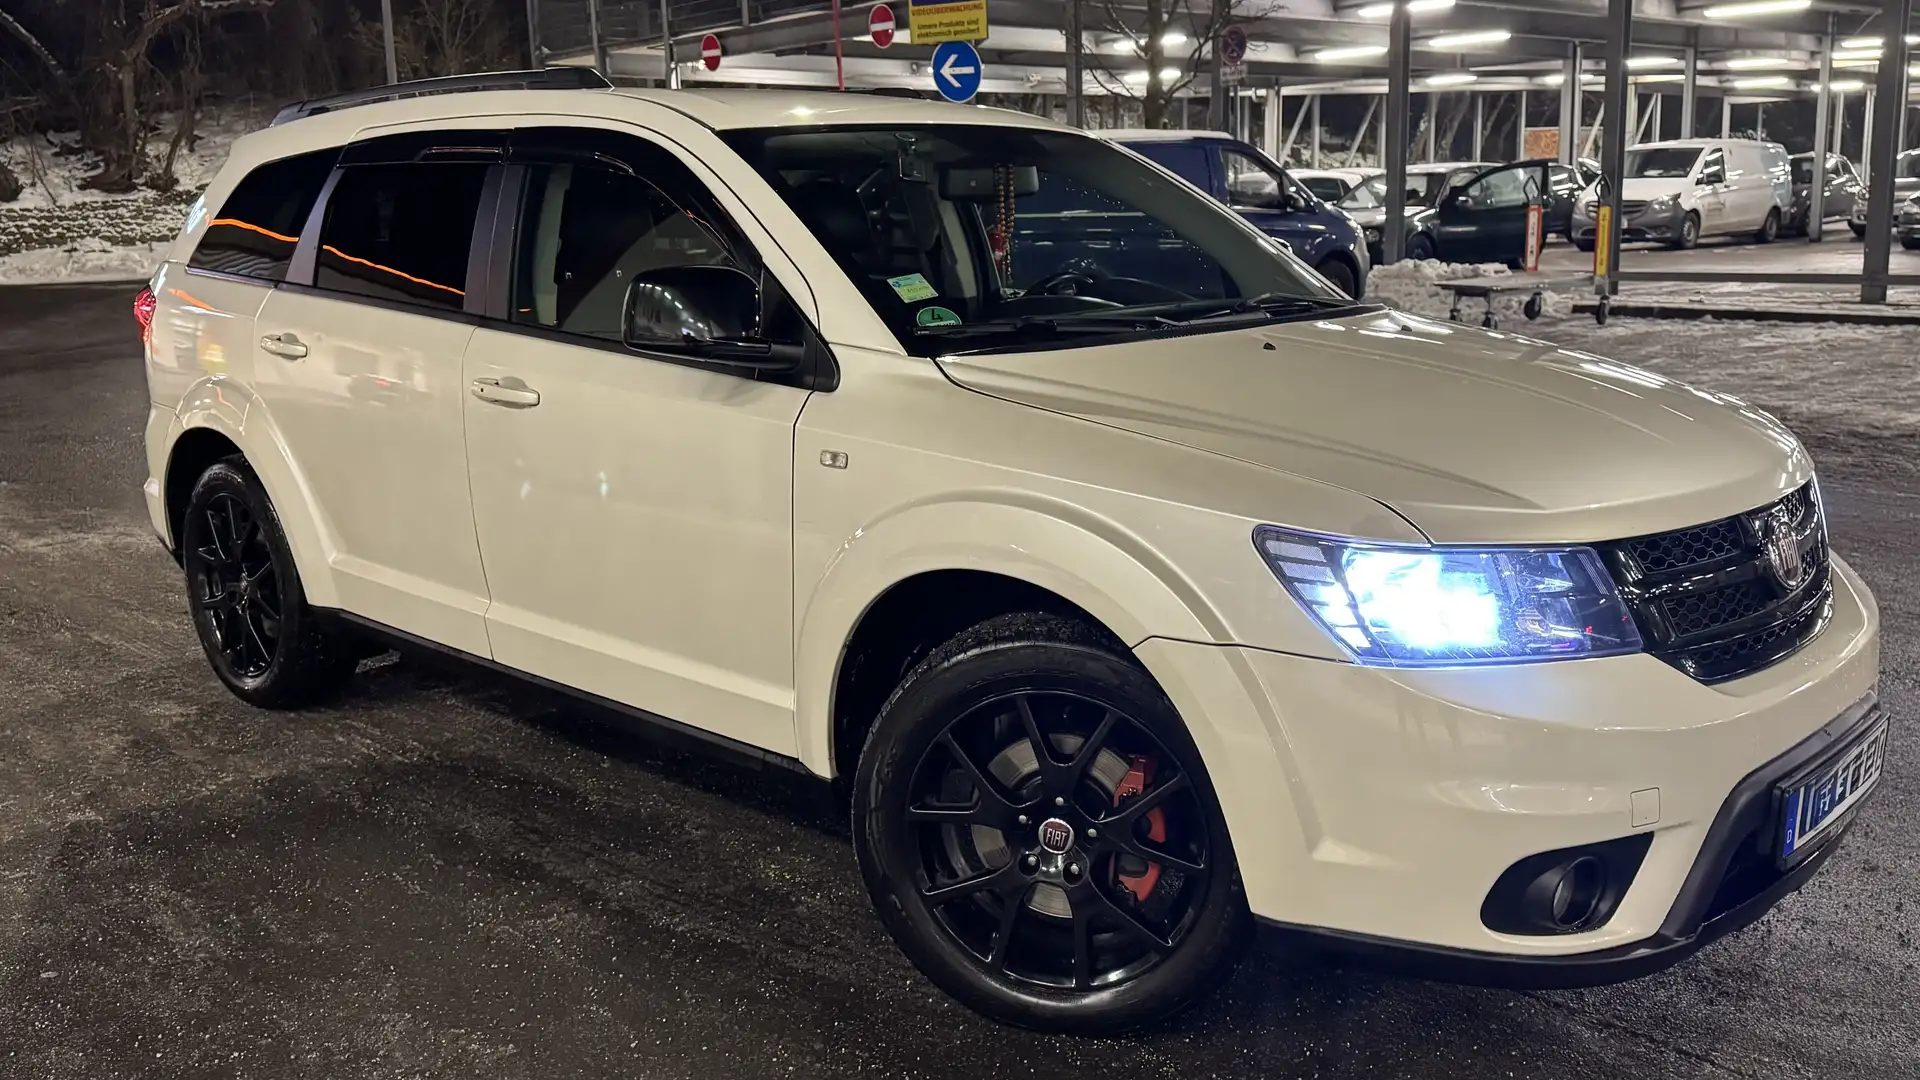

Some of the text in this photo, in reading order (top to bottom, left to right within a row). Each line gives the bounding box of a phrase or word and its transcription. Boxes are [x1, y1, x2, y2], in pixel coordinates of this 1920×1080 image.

[939, 20, 965, 28] Produkte
[967, 17, 979, 26] sind
[931, 308, 943, 321] 4
[1778, 537, 1799, 571] FIAT
[1046, 828, 1068, 847] FIAT
